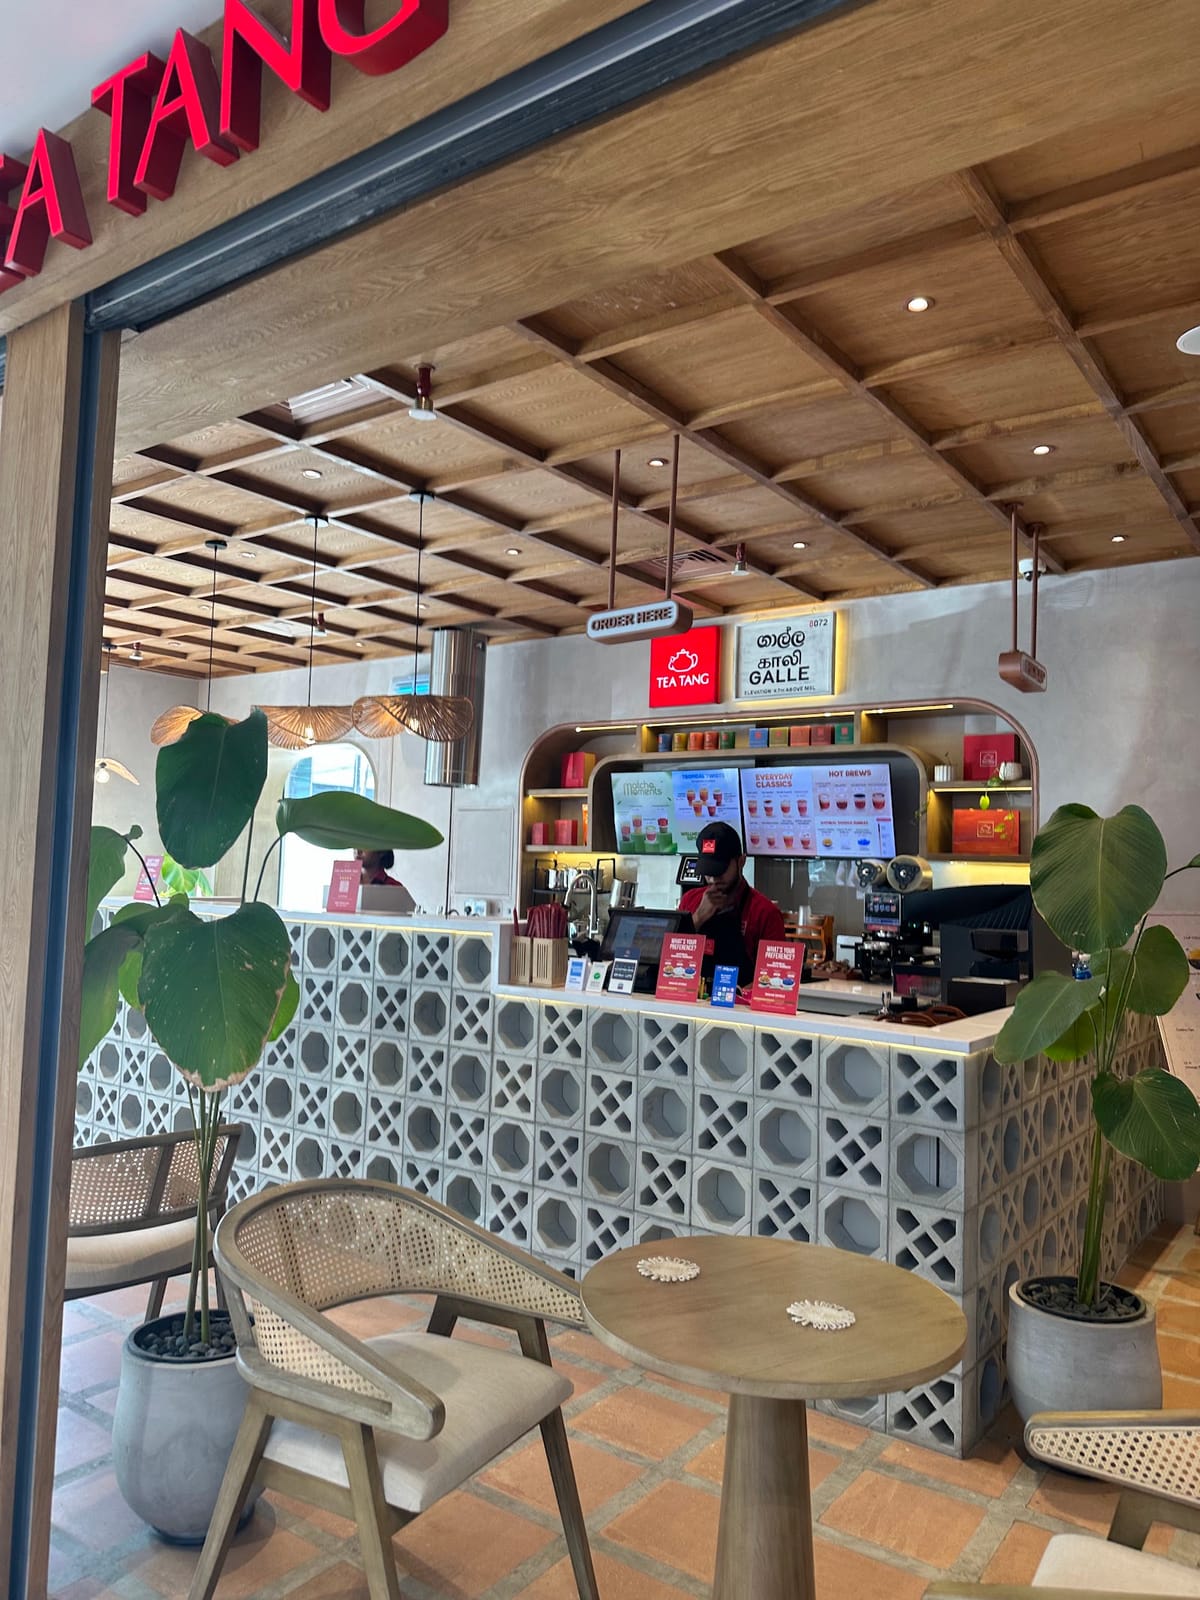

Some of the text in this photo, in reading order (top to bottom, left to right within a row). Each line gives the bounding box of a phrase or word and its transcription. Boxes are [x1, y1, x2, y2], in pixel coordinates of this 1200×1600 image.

[591, 606, 673, 631] ORDER HERE
[757, 626, 805, 649] ගාල්ල
[757, 649, 802, 669] காலி
[656, 673, 710, 689] TEA TANG
[749, 666, 810, 685] GALLE
[846, 769, 872, 777] BREWS
